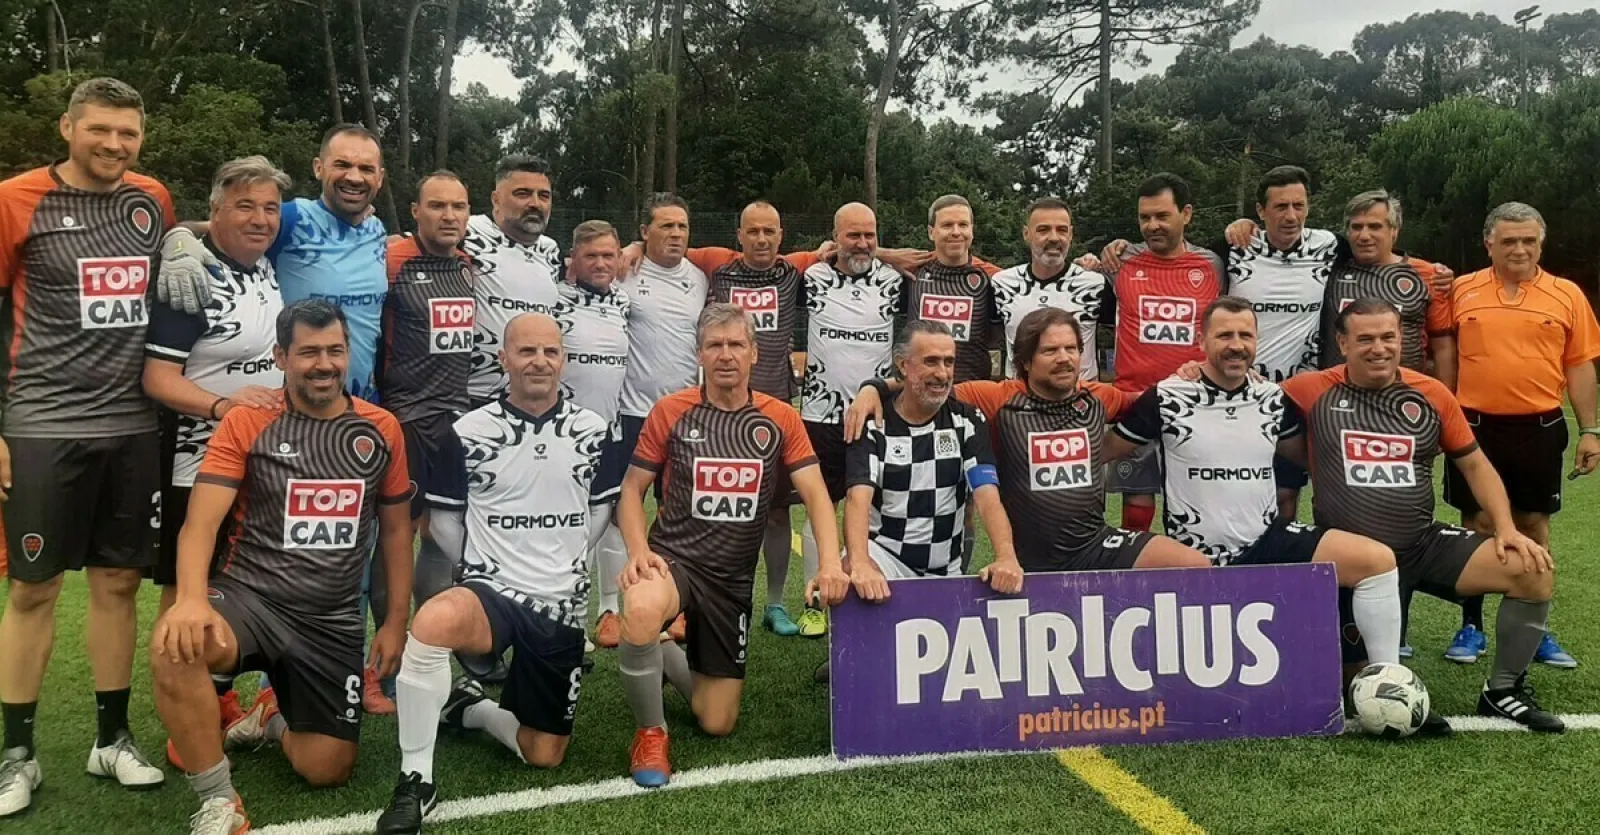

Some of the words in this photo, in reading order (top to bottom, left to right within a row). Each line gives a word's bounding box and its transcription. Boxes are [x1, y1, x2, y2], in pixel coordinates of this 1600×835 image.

[87, 266, 145, 291] TOP
[735, 291, 773, 307] TOP
[925, 299, 968, 316] TOP
[1250, 302, 1321, 313] ORMOVE
[88, 300, 143, 324] CAR
[435, 304, 473, 323] TOP
[1143, 302, 1191, 319] TOP
[435, 331, 473, 350] CAR
[820, 328, 888, 342] FORMOVES
[1143, 324, 1190, 342] CAR
[1034, 436, 1085, 459] TOP
[1347, 437, 1408, 458] TOP
[700, 466, 757, 488] TOP
[1035, 464, 1088, 487] CAR
[1188, 467, 1272, 480] FORMOVE
[1350, 464, 1412, 484] CAR
[294, 488, 357, 512] TOP
[696, 495, 753, 518] CAR
[290, 521, 353, 545] CAR
[895, 592, 1280, 704] PATRICIUS
[1019, 700, 1165, 741] patricius.pt
